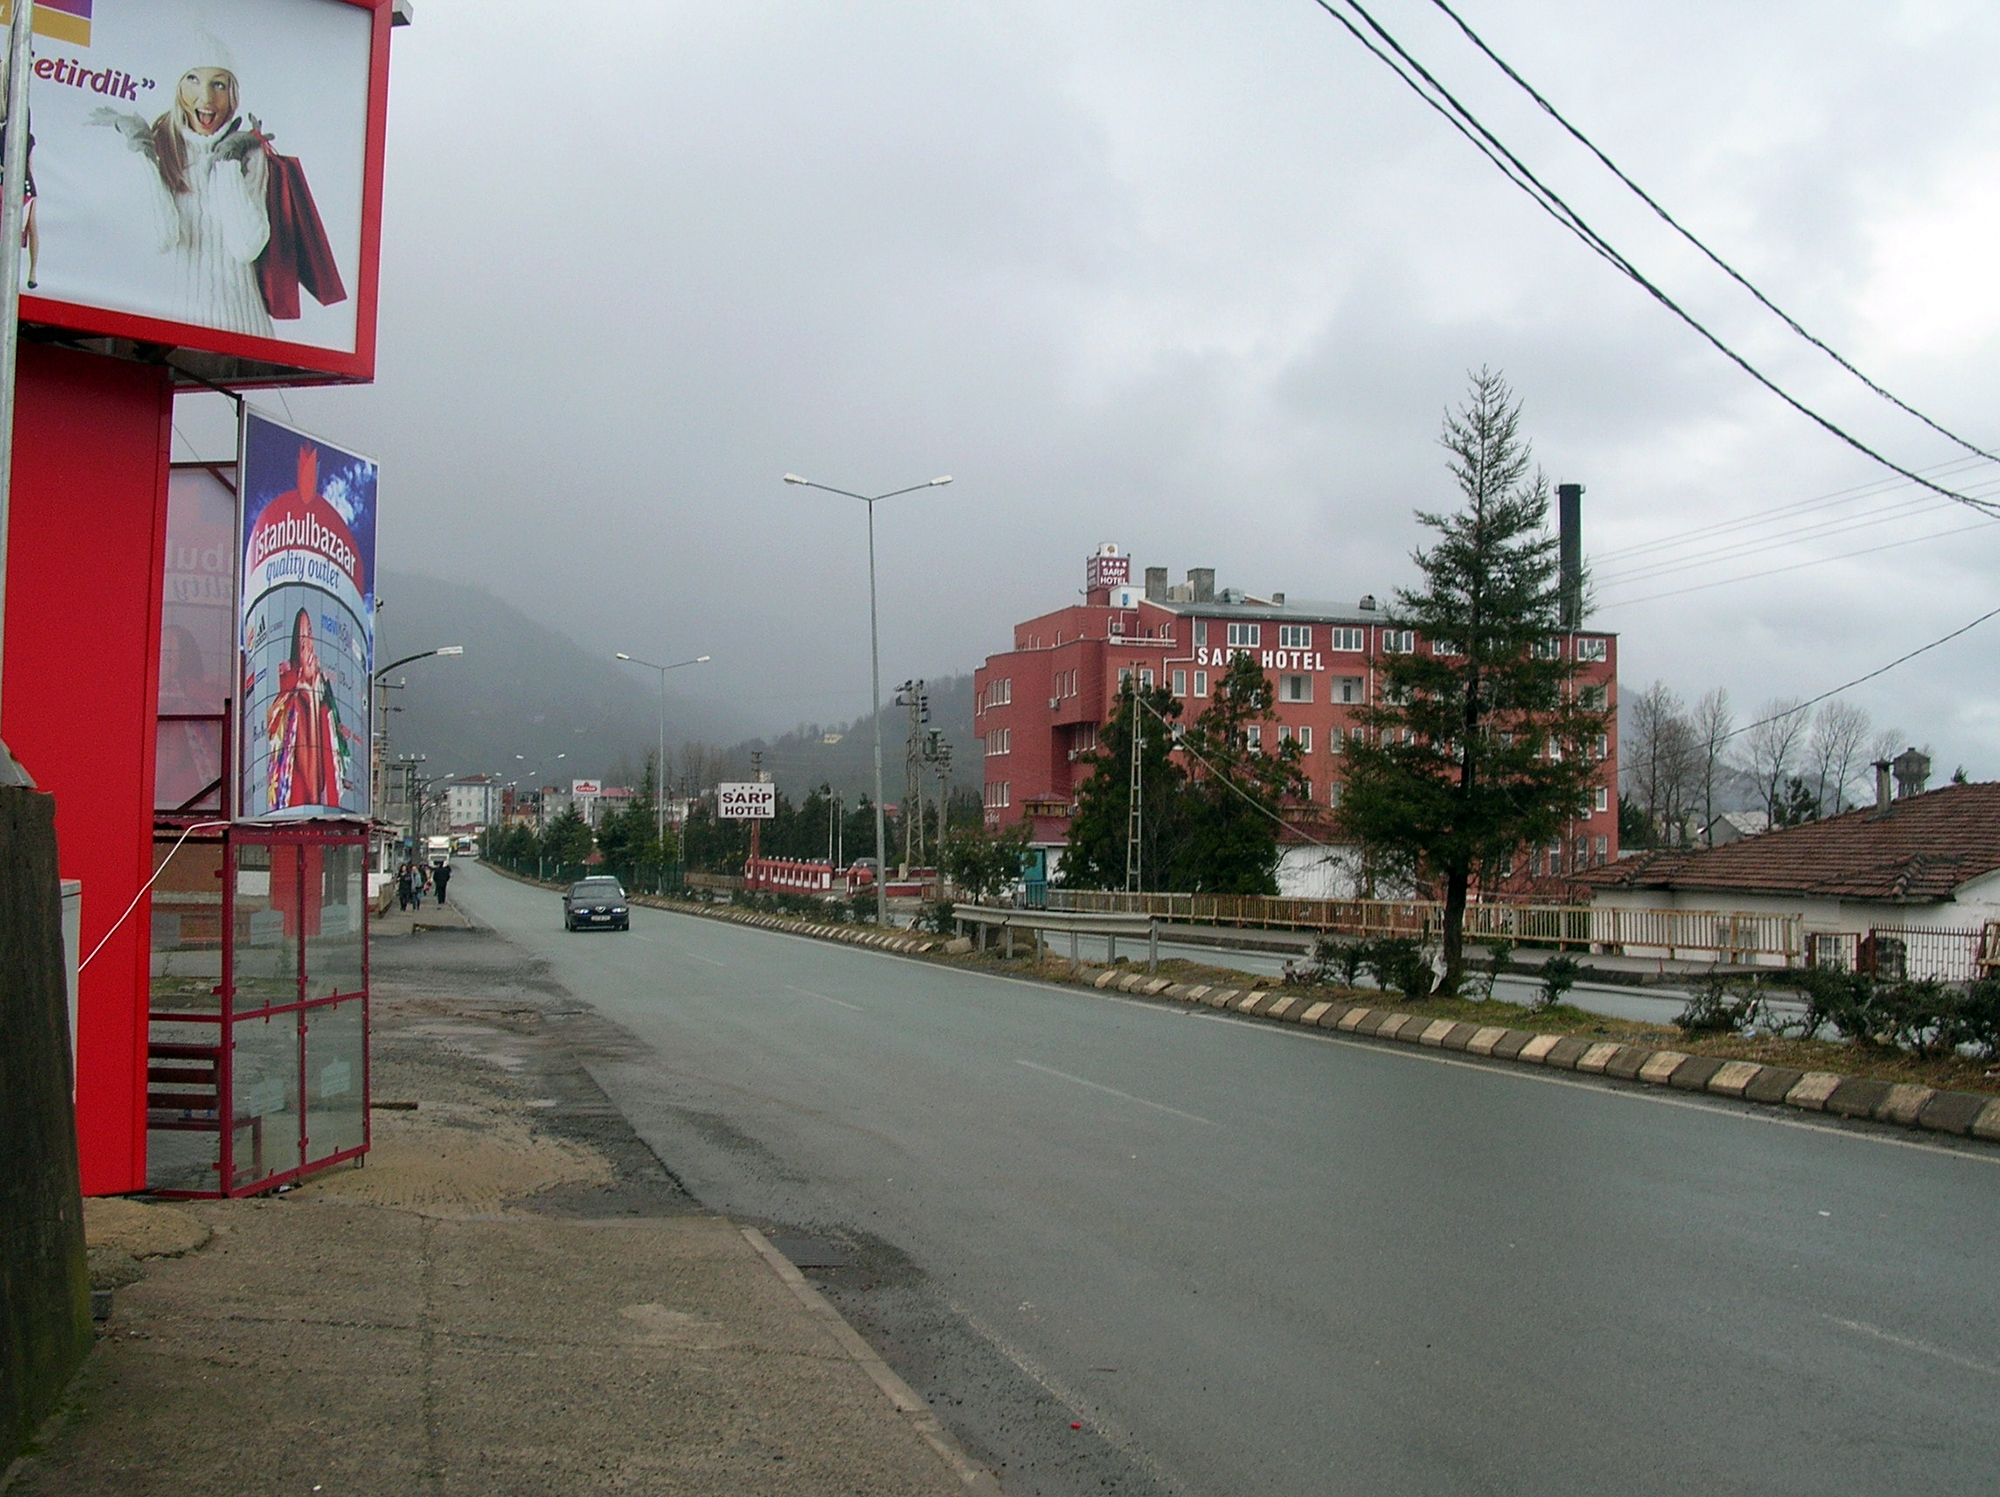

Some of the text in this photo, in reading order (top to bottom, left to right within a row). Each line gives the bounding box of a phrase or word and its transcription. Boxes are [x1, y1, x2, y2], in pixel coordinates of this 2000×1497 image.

[255, 511, 356, 577] istanbulbazaar
[266, 550, 306, 587] quality
[308, 559, 340, 589] outlet
[1100, 577, 1128, 585] HOTEL
[1261, 650, 1325, 671] HOTEL
[722, 792, 773, 804] SARP
[725, 806, 770, 816] HOTEL
